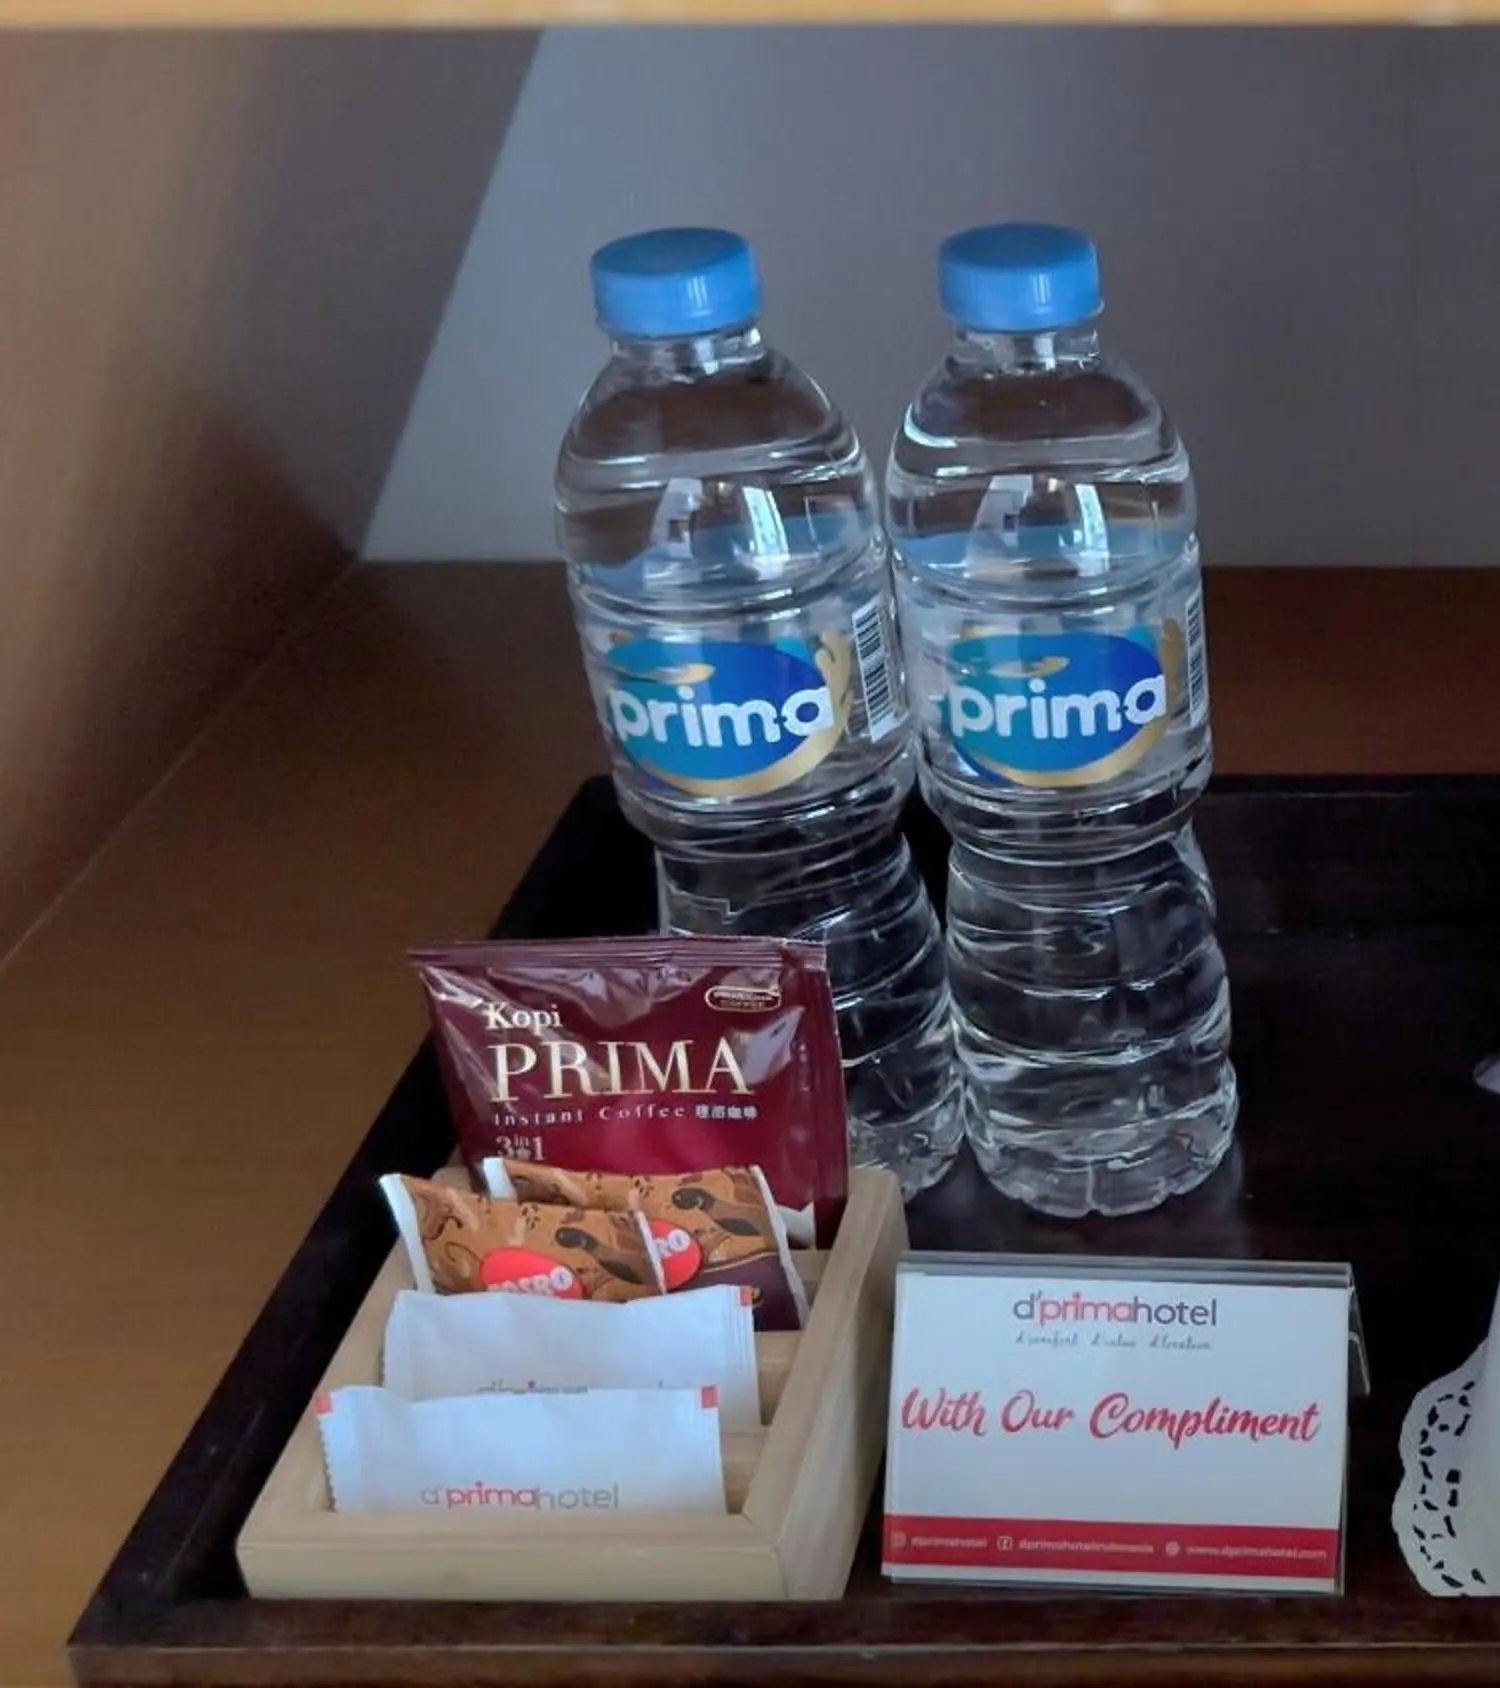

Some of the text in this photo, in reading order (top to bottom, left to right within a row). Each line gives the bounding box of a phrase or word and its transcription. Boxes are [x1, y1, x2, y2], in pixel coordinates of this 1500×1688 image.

[607, 685, 834, 748] prima
[951, 677, 1167, 739] prima
[485, 1003, 564, 1037] Kopi
[487, 1037, 754, 1102] PRIMA
[494, 1103, 685, 1127] Instant Coffee
[901, 1386, 1322, 1450] With Our Compliment
